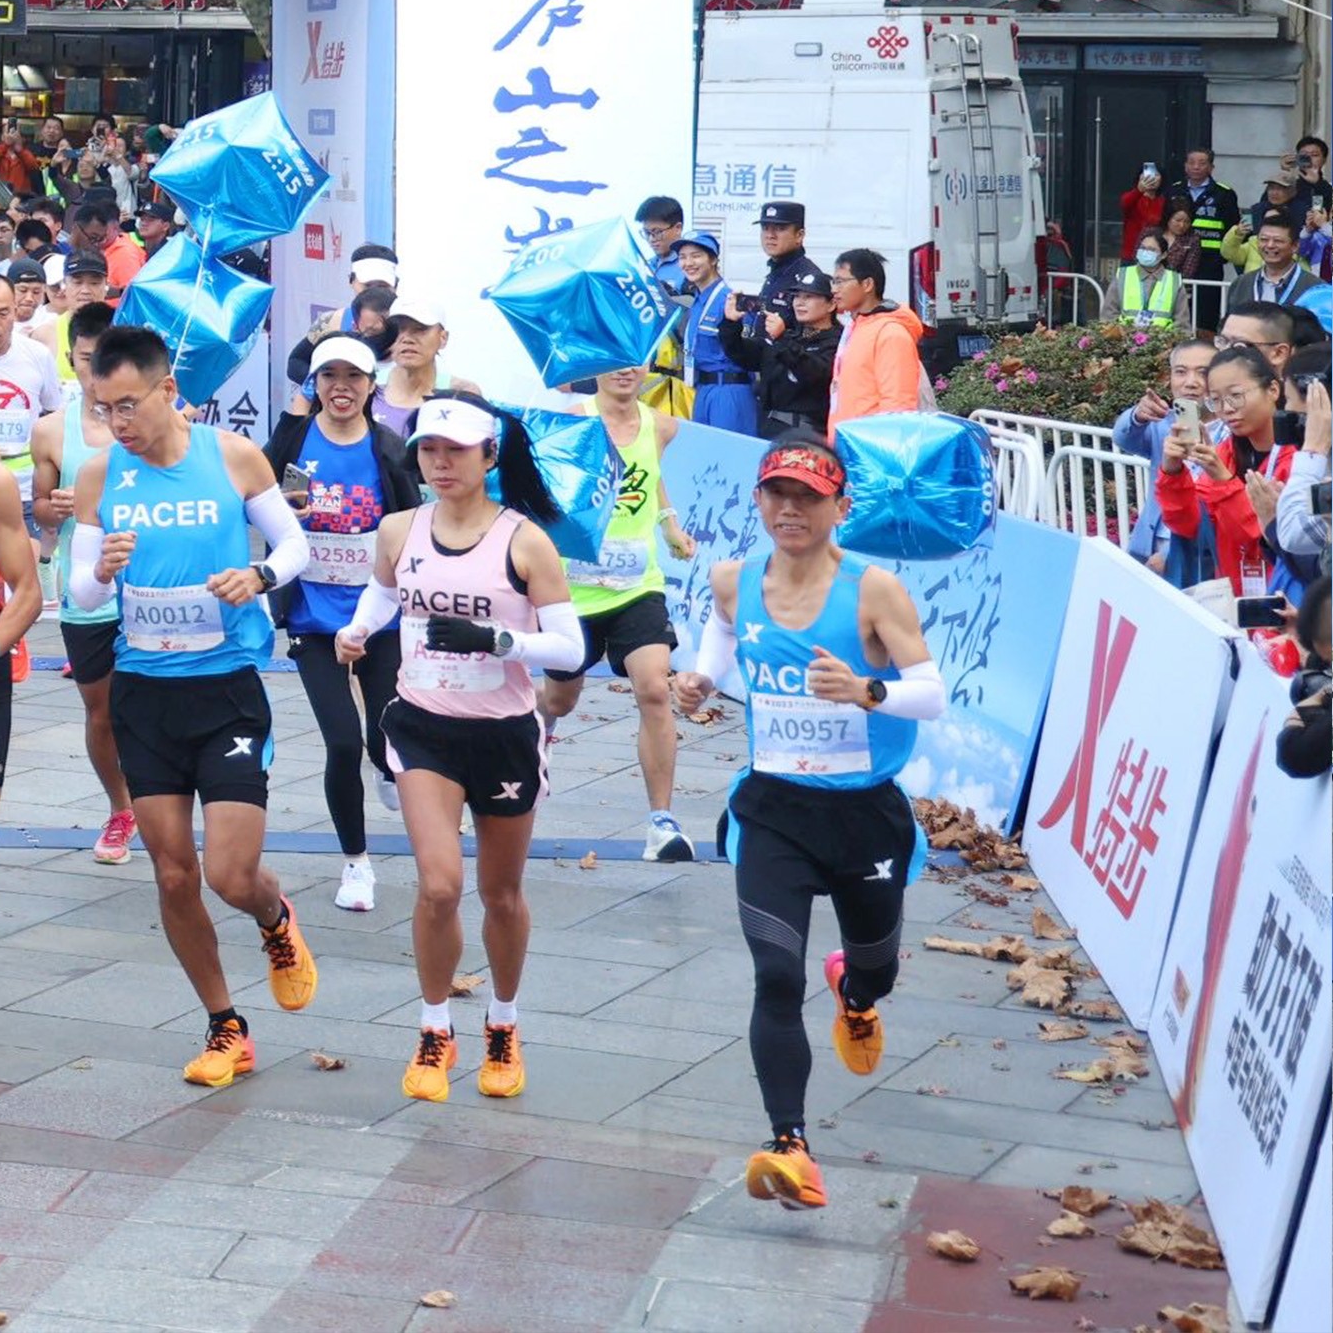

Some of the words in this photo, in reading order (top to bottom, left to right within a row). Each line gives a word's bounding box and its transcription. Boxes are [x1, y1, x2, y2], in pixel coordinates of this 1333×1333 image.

[831, 52, 863, 63] China
[832, 62, 870, 72] unicom
[262, 148, 302, 195] 2:15
[615, 269, 655, 324] 2:00
[113, 499, 220, 529] PACER
[309, 546, 368, 564] A2582
[134, 605, 206, 624] A0012
[399, 587, 492, 618] PACER
[768, 717, 850, 741] A0957
